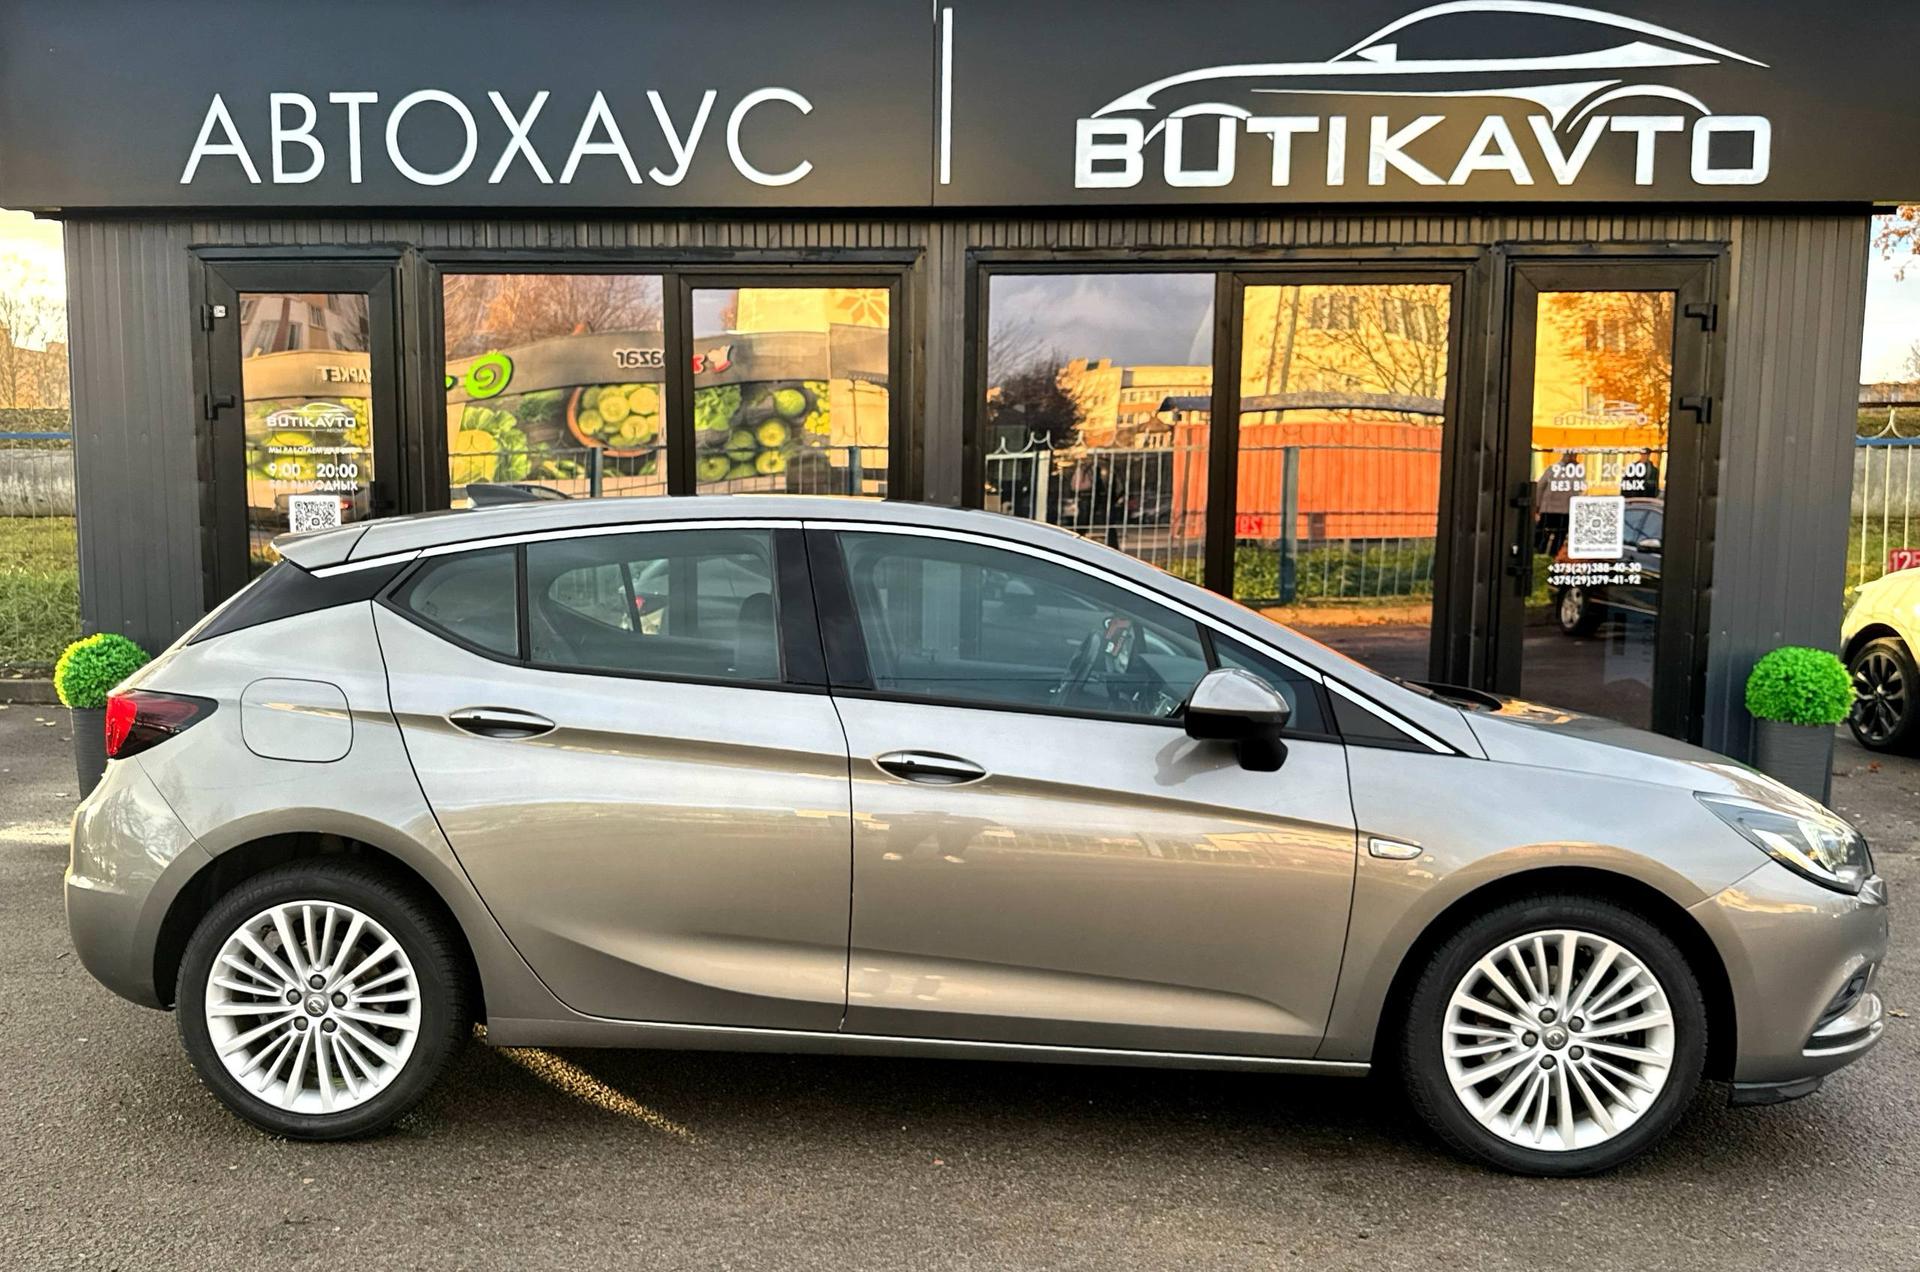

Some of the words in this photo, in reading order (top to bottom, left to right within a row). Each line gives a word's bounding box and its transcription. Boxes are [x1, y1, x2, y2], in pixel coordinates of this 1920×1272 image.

[180, 88, 814, 187] АВТОХАУС
[1074, 114, 1772, 188] BUTIKAVTO
[266, 416, 356, 428] BUTIKAVTO
[316, 463, 358, 478] 20:00
[1552, 463, 1585, 477] 9:00
[1550, 480, 1570, 491] БЕЗ
